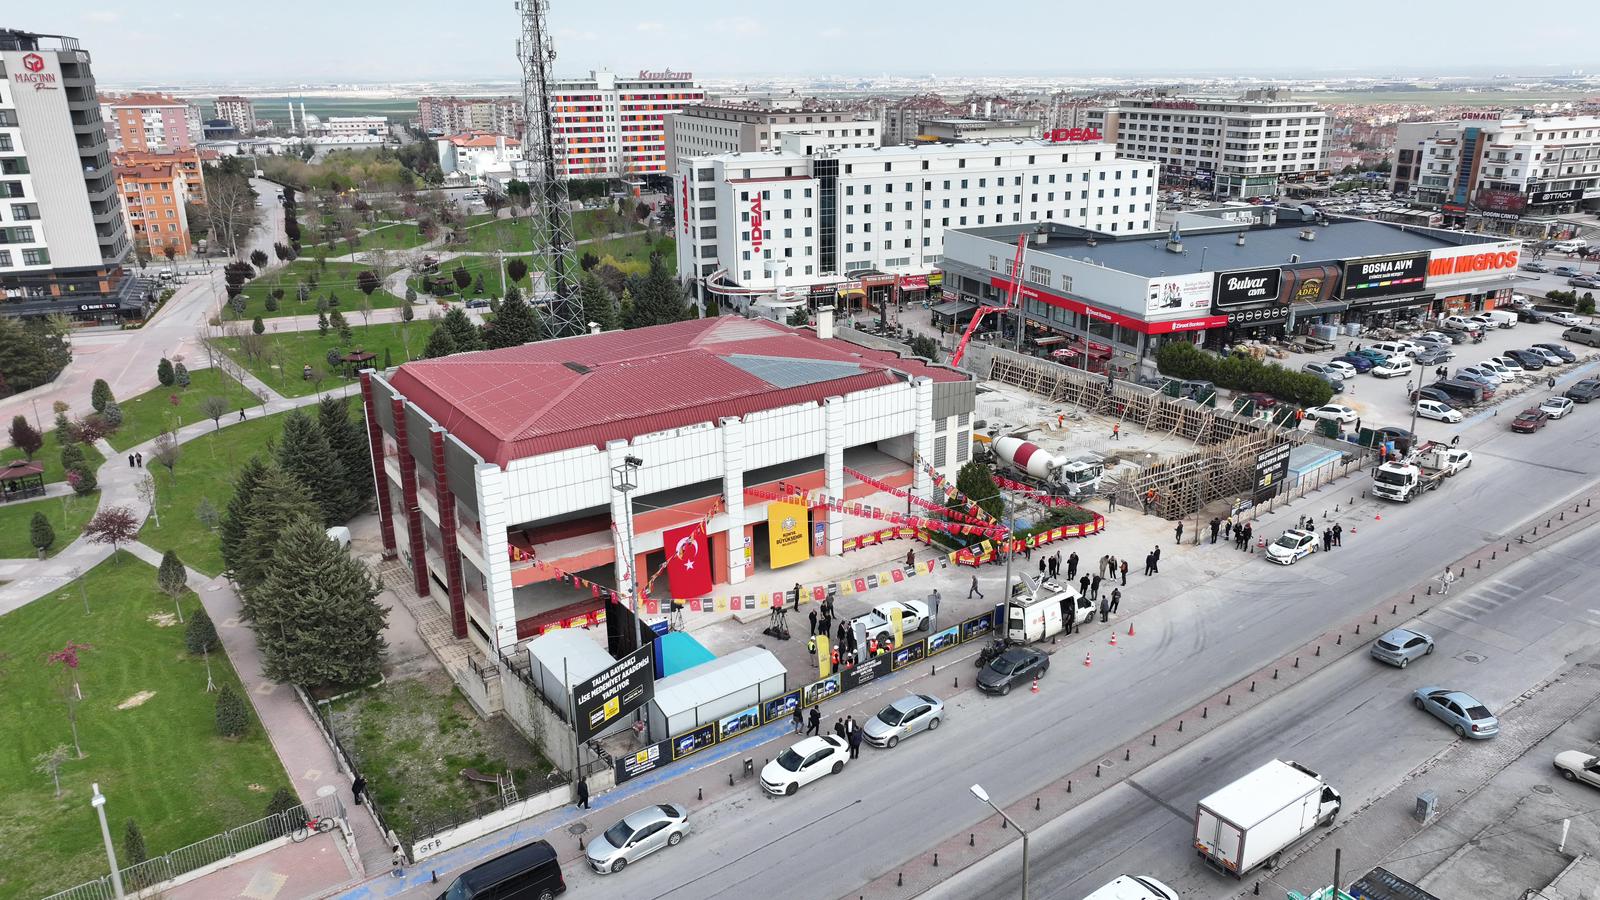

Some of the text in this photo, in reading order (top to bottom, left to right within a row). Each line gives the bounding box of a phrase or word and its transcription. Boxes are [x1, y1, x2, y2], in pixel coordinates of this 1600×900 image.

[751, 191, 762, 246] IDEAL
[1362, 259, 1413, 274] BOSNA AVM
[1455, 251, 1518, 273] MIGROS
[1227, 277, 1267, 291] Bulvar
[1248, 287, 1266, 297] avm
[592, 672, 610, 687] TALHA
[578, 691, 591, 706] LİSE
